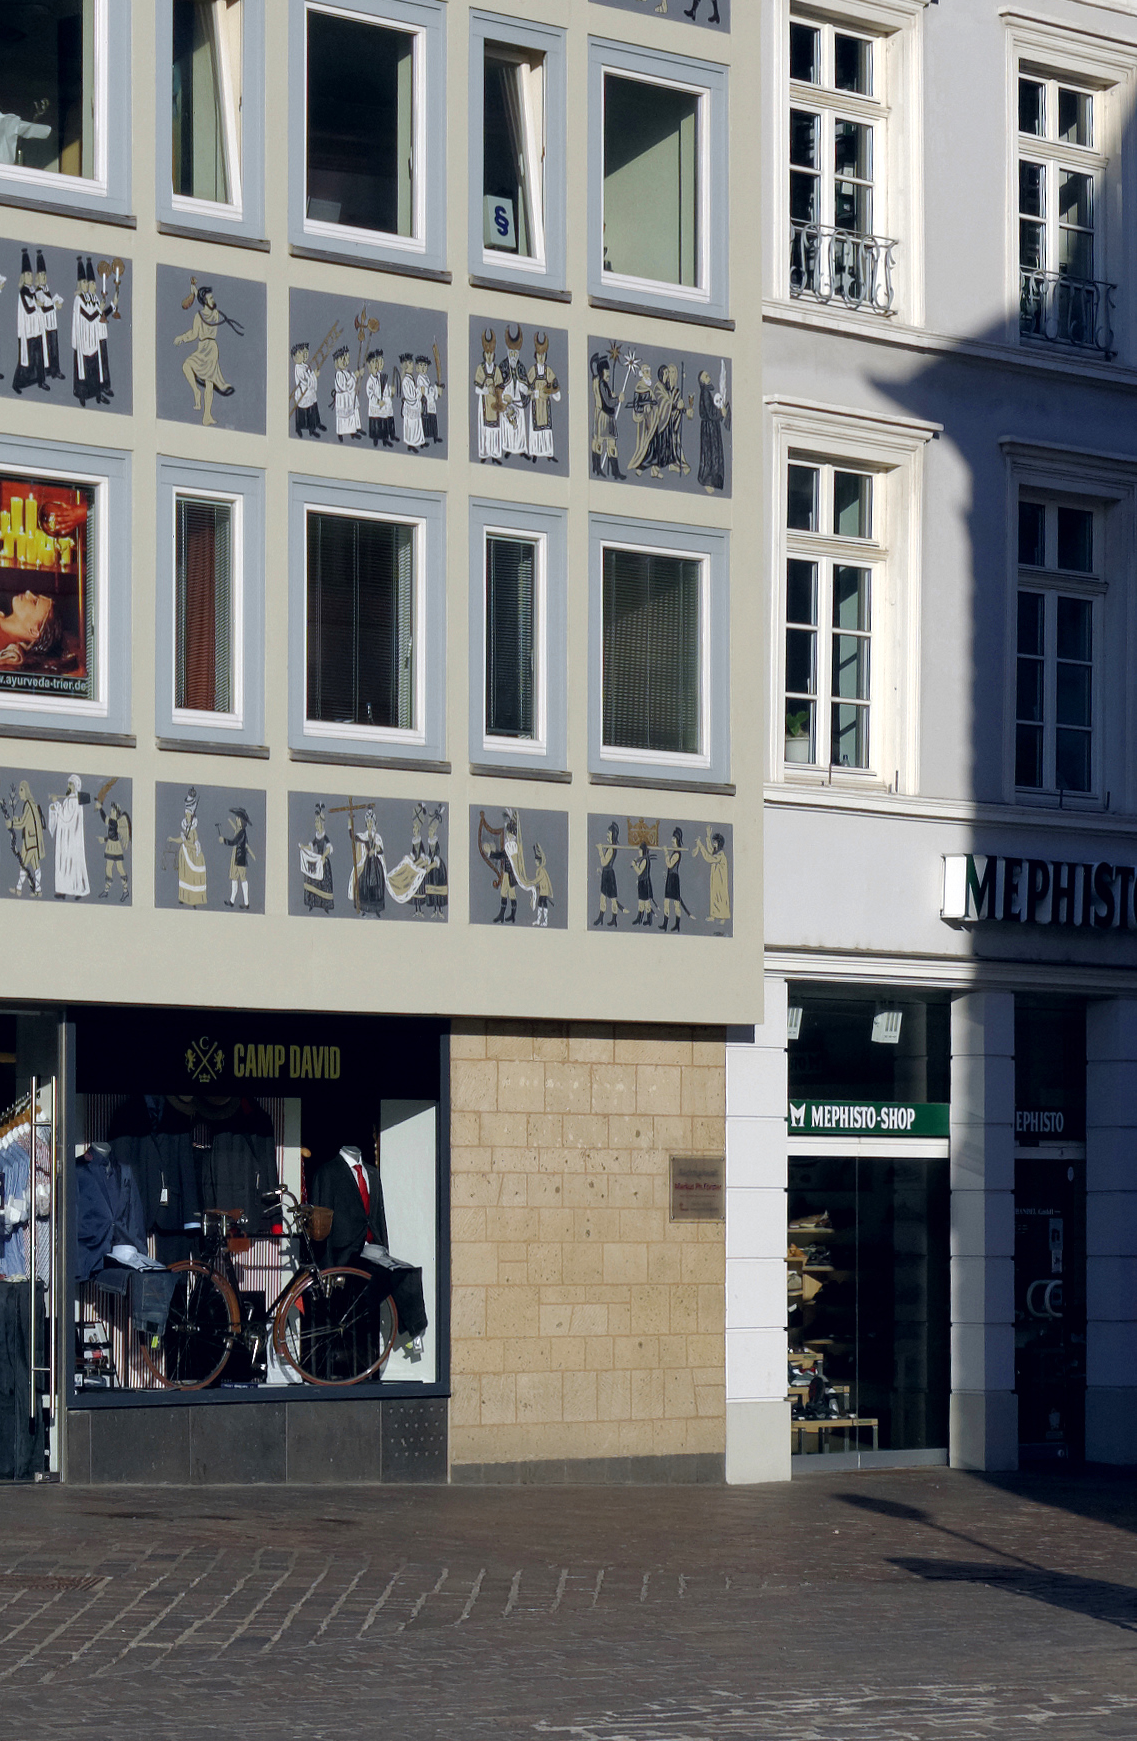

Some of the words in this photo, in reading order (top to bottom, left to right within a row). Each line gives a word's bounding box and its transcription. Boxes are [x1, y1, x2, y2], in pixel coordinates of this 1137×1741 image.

[966, 854, 1137, 928] MEPHIST
[233, 1043, 286, 1078] CAMP
[289, 1045, 341, 1080] DAVID
[811, 1105, 916, 1131] MEPHISTO-SHOP
